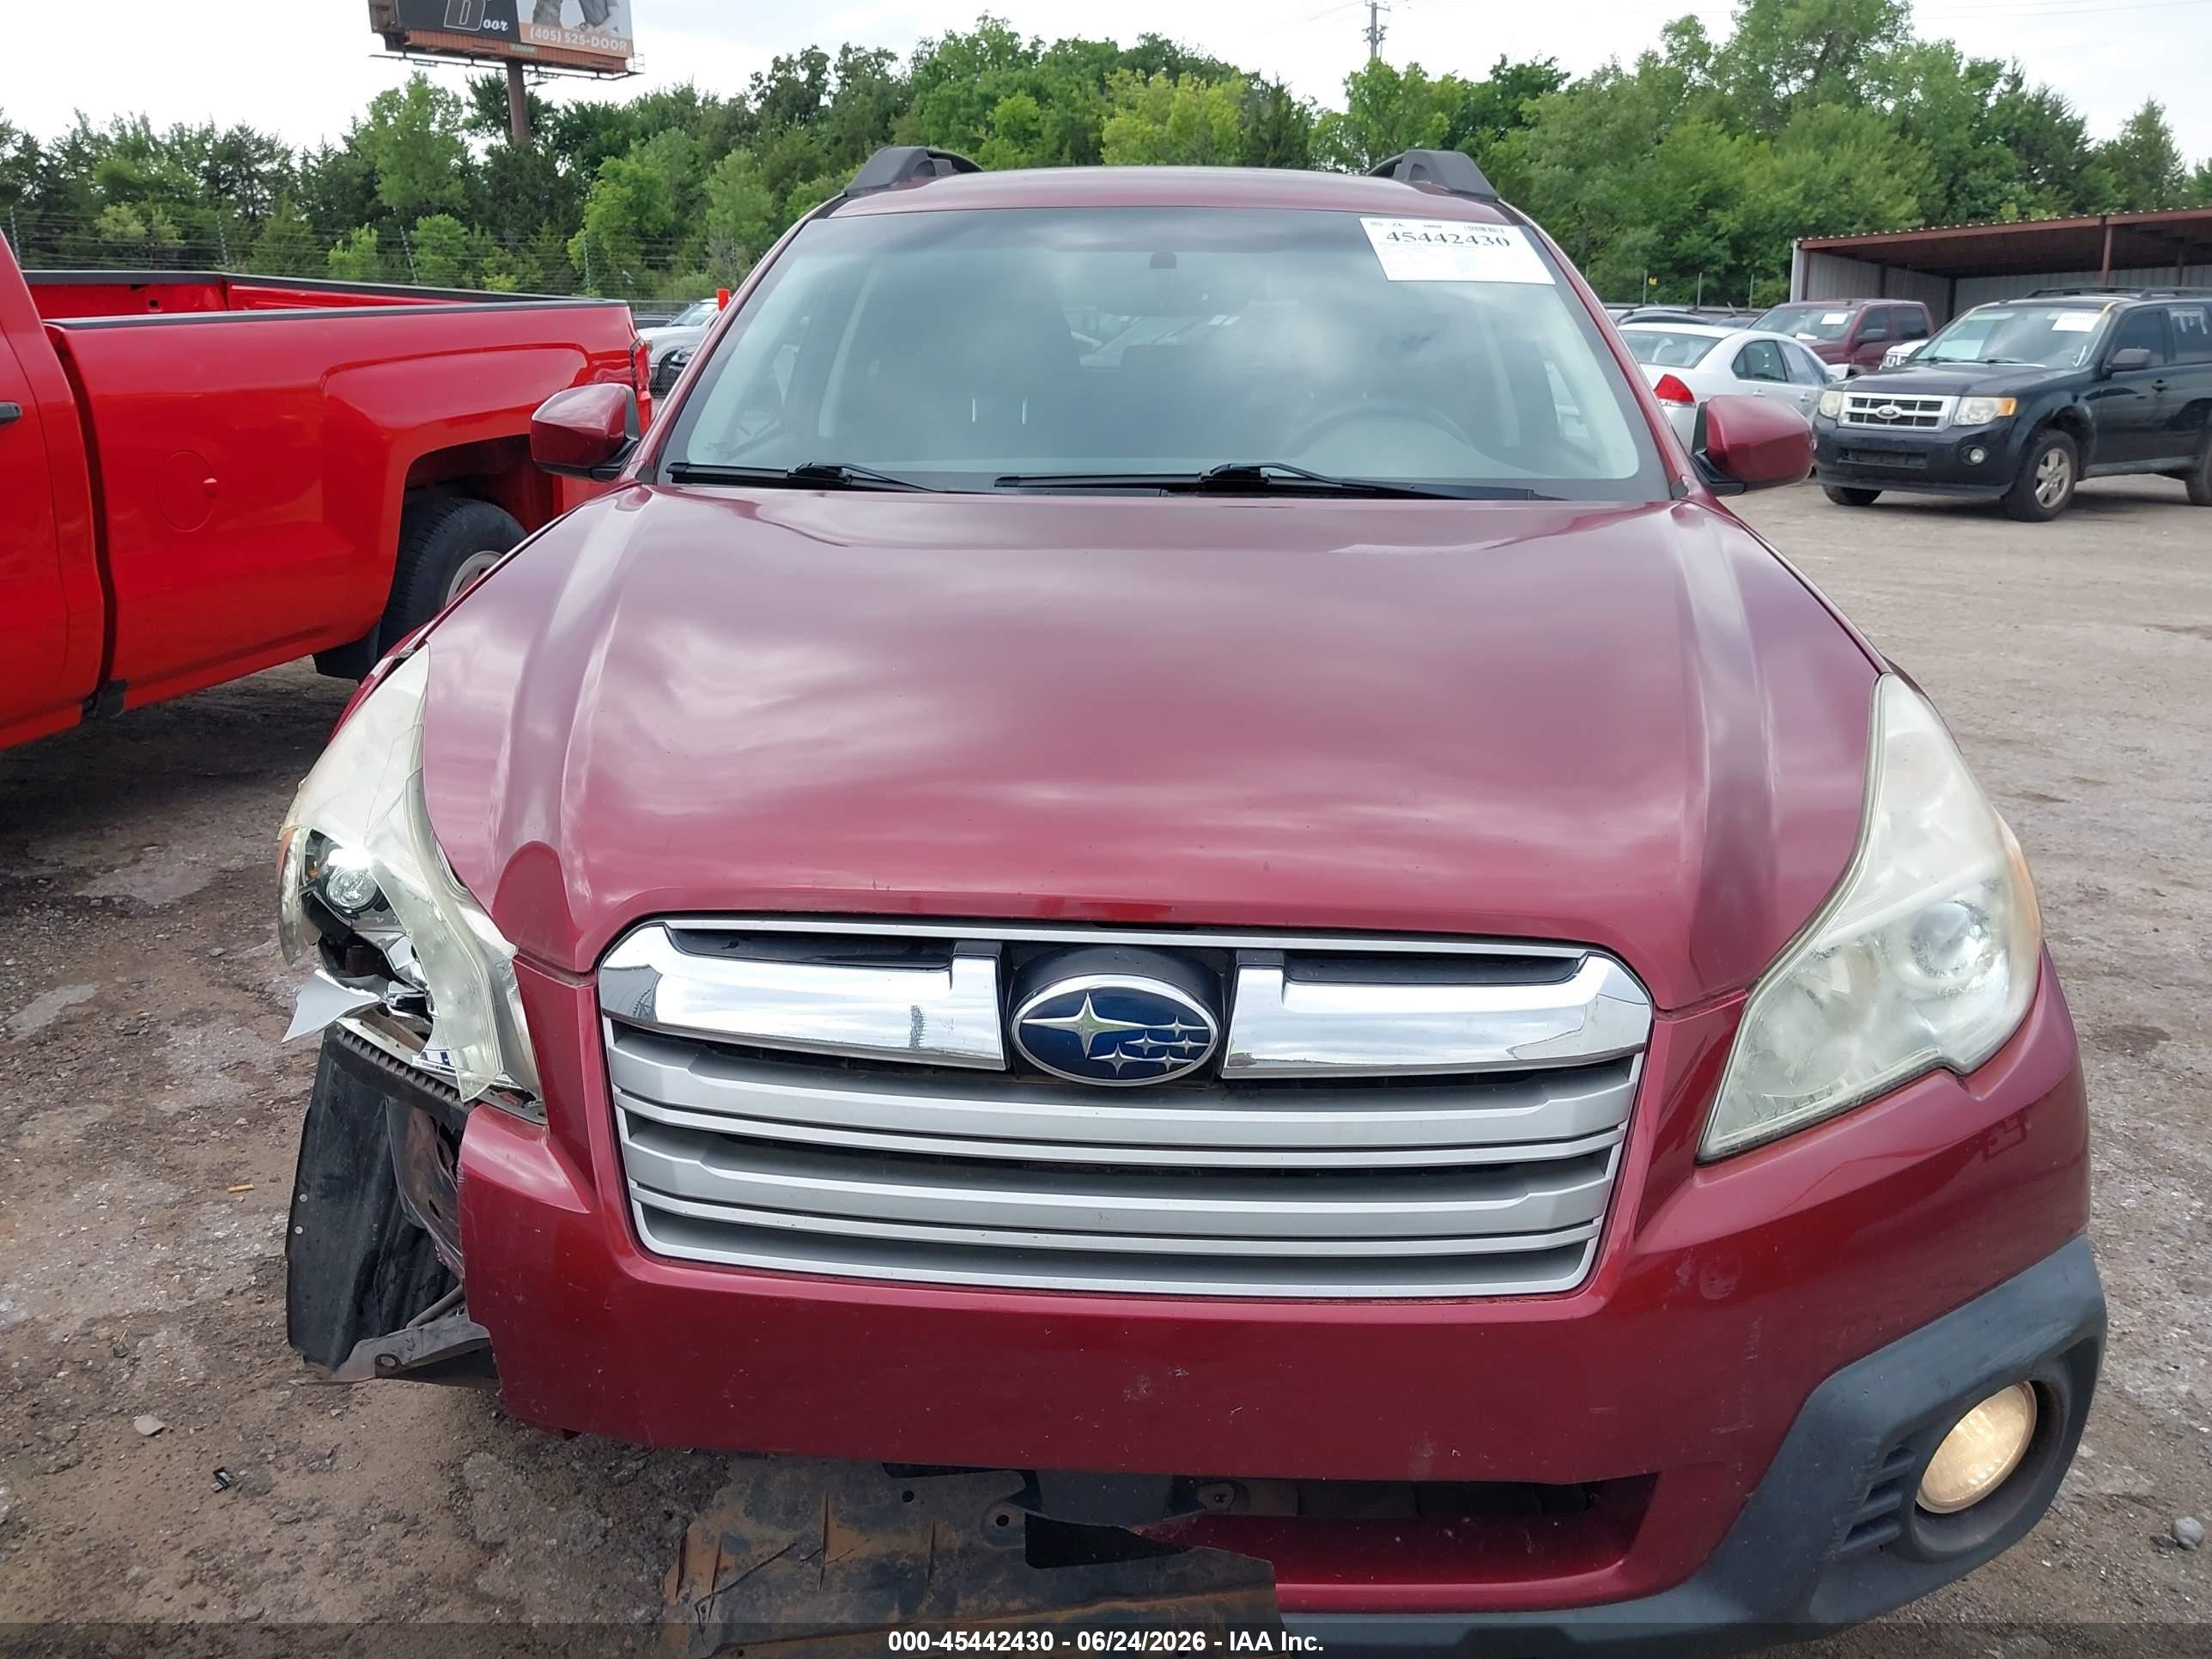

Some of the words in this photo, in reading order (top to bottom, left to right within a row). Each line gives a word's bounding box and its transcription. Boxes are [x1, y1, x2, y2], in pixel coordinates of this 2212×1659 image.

[529, 24, 562, 43] (405)
[563, 32, 628, 52] 525-DOOR
[1386, 230, 1510, 247] 45442430
